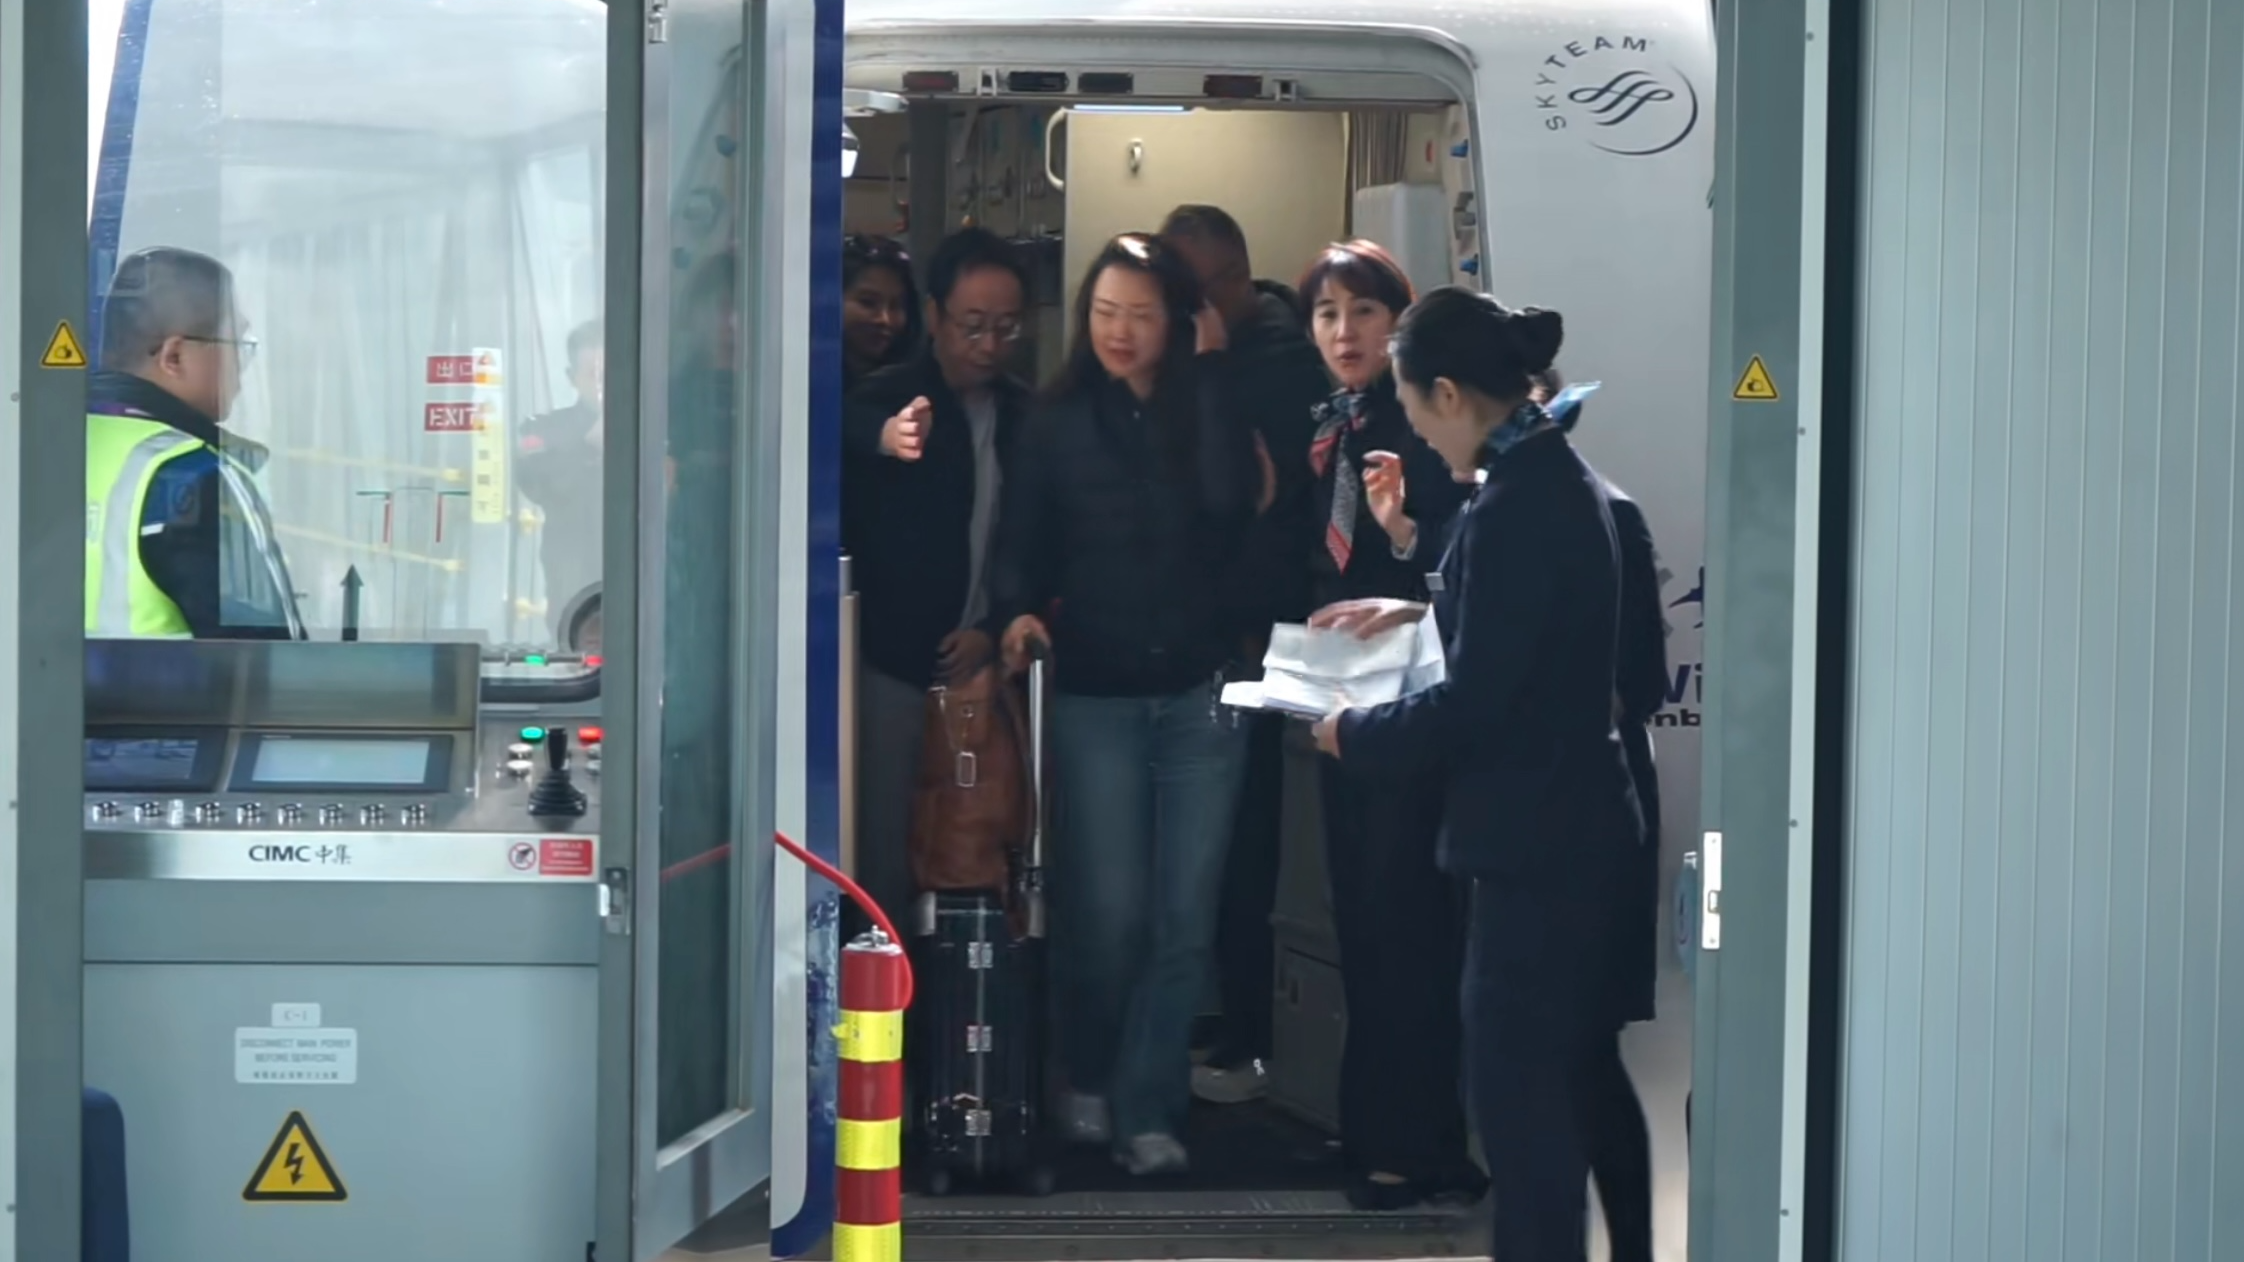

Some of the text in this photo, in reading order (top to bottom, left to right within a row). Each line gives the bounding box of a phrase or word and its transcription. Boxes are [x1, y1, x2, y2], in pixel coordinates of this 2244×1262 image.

[1534, 36, 1648, 131] SKYTEAM
[436, 361, 476, 378] 出口
[429, 407, 480, 427] EXIT
[249, 844, 352, 864] CIMC 中集
